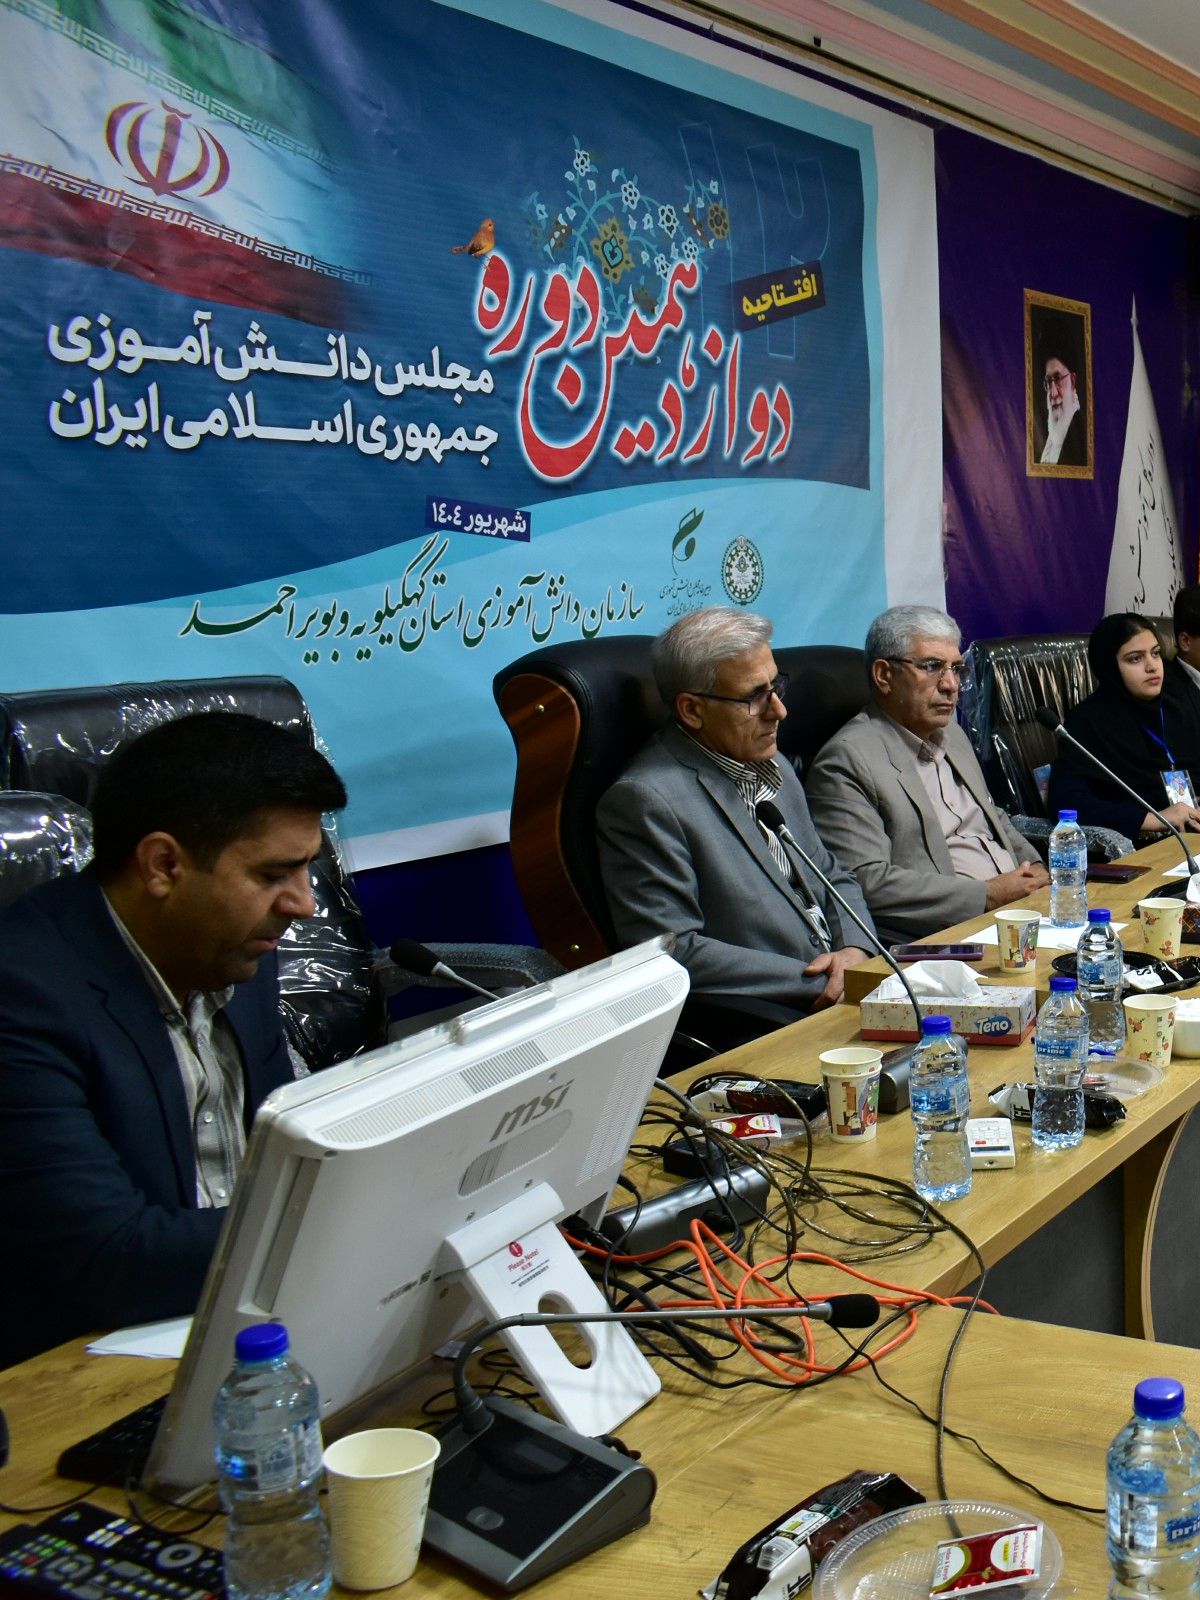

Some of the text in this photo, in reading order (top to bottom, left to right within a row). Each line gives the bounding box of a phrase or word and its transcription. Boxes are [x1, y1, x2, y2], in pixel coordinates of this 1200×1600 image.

[476, 252, 600, 357] دوره
[742, 273, 818, 321] افتتاحیه
[373, 346, 495, 404] مجلس
[48, 377, 500, 467] جمهوری اسلامی ایران
[463, 511, 527, 537] شهریور
[398, 572, 464, 653] استان
[580, 580, 645, 640] سازمان
[976, 1017, 1009, 1035] Teno
[489, 1078, 576, 1142] msi
